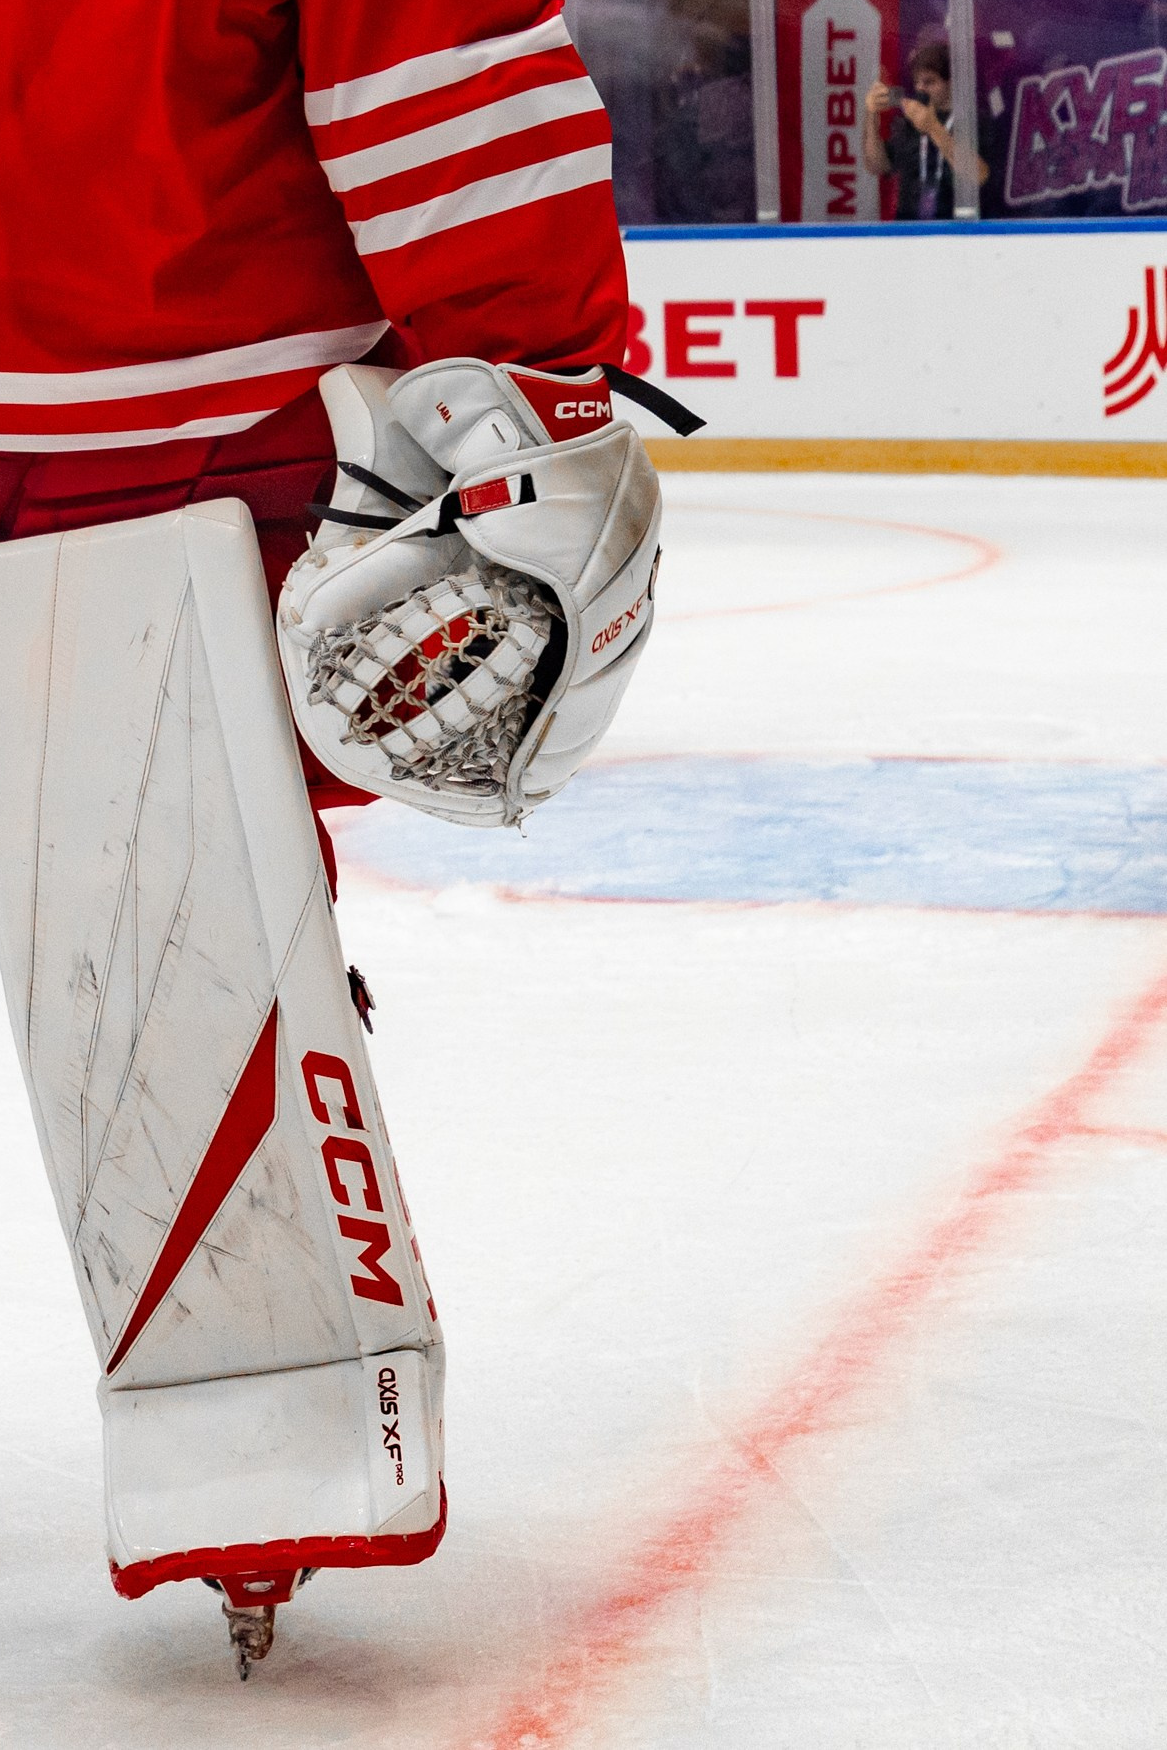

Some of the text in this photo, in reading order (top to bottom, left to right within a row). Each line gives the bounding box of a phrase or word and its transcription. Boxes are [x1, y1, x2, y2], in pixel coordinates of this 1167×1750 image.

[435, 400, 453, 425] LARA
[554, 400, 611, 420] CCM
[300, 1049, 405, 1308] CCM
[394, 1462, 404, 1487] PRO
